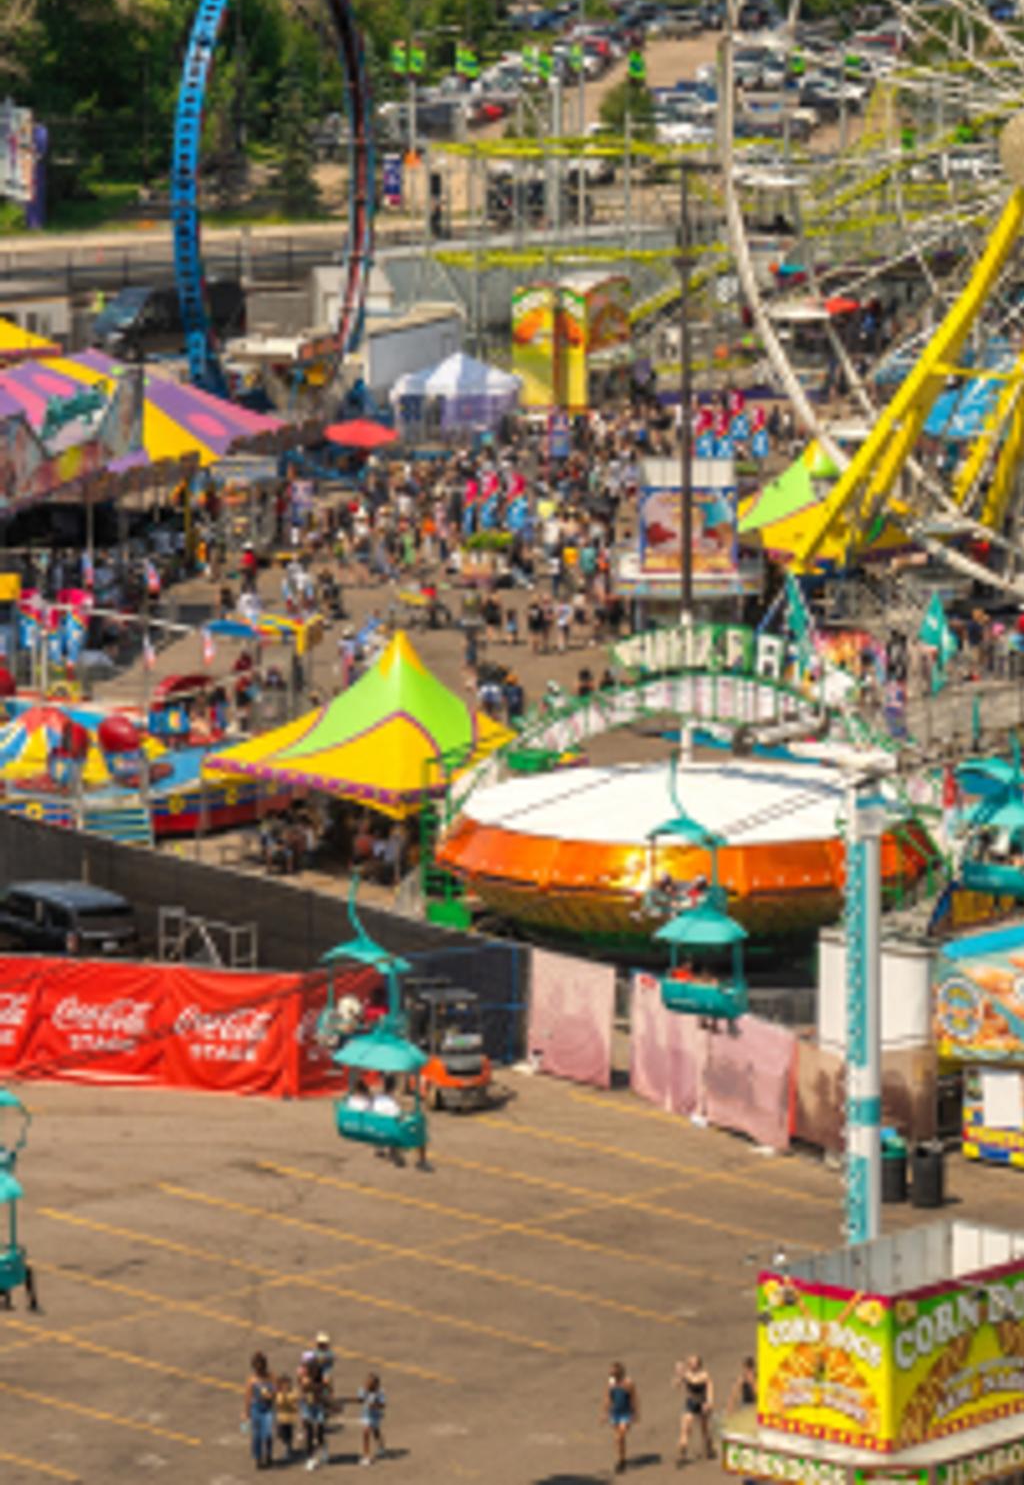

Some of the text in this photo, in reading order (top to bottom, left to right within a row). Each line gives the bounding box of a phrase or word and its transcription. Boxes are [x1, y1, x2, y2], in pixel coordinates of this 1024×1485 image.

[767, 1318, 882, 1368] CORN DOGS
[895, 1292, 980, 1369] CORN
